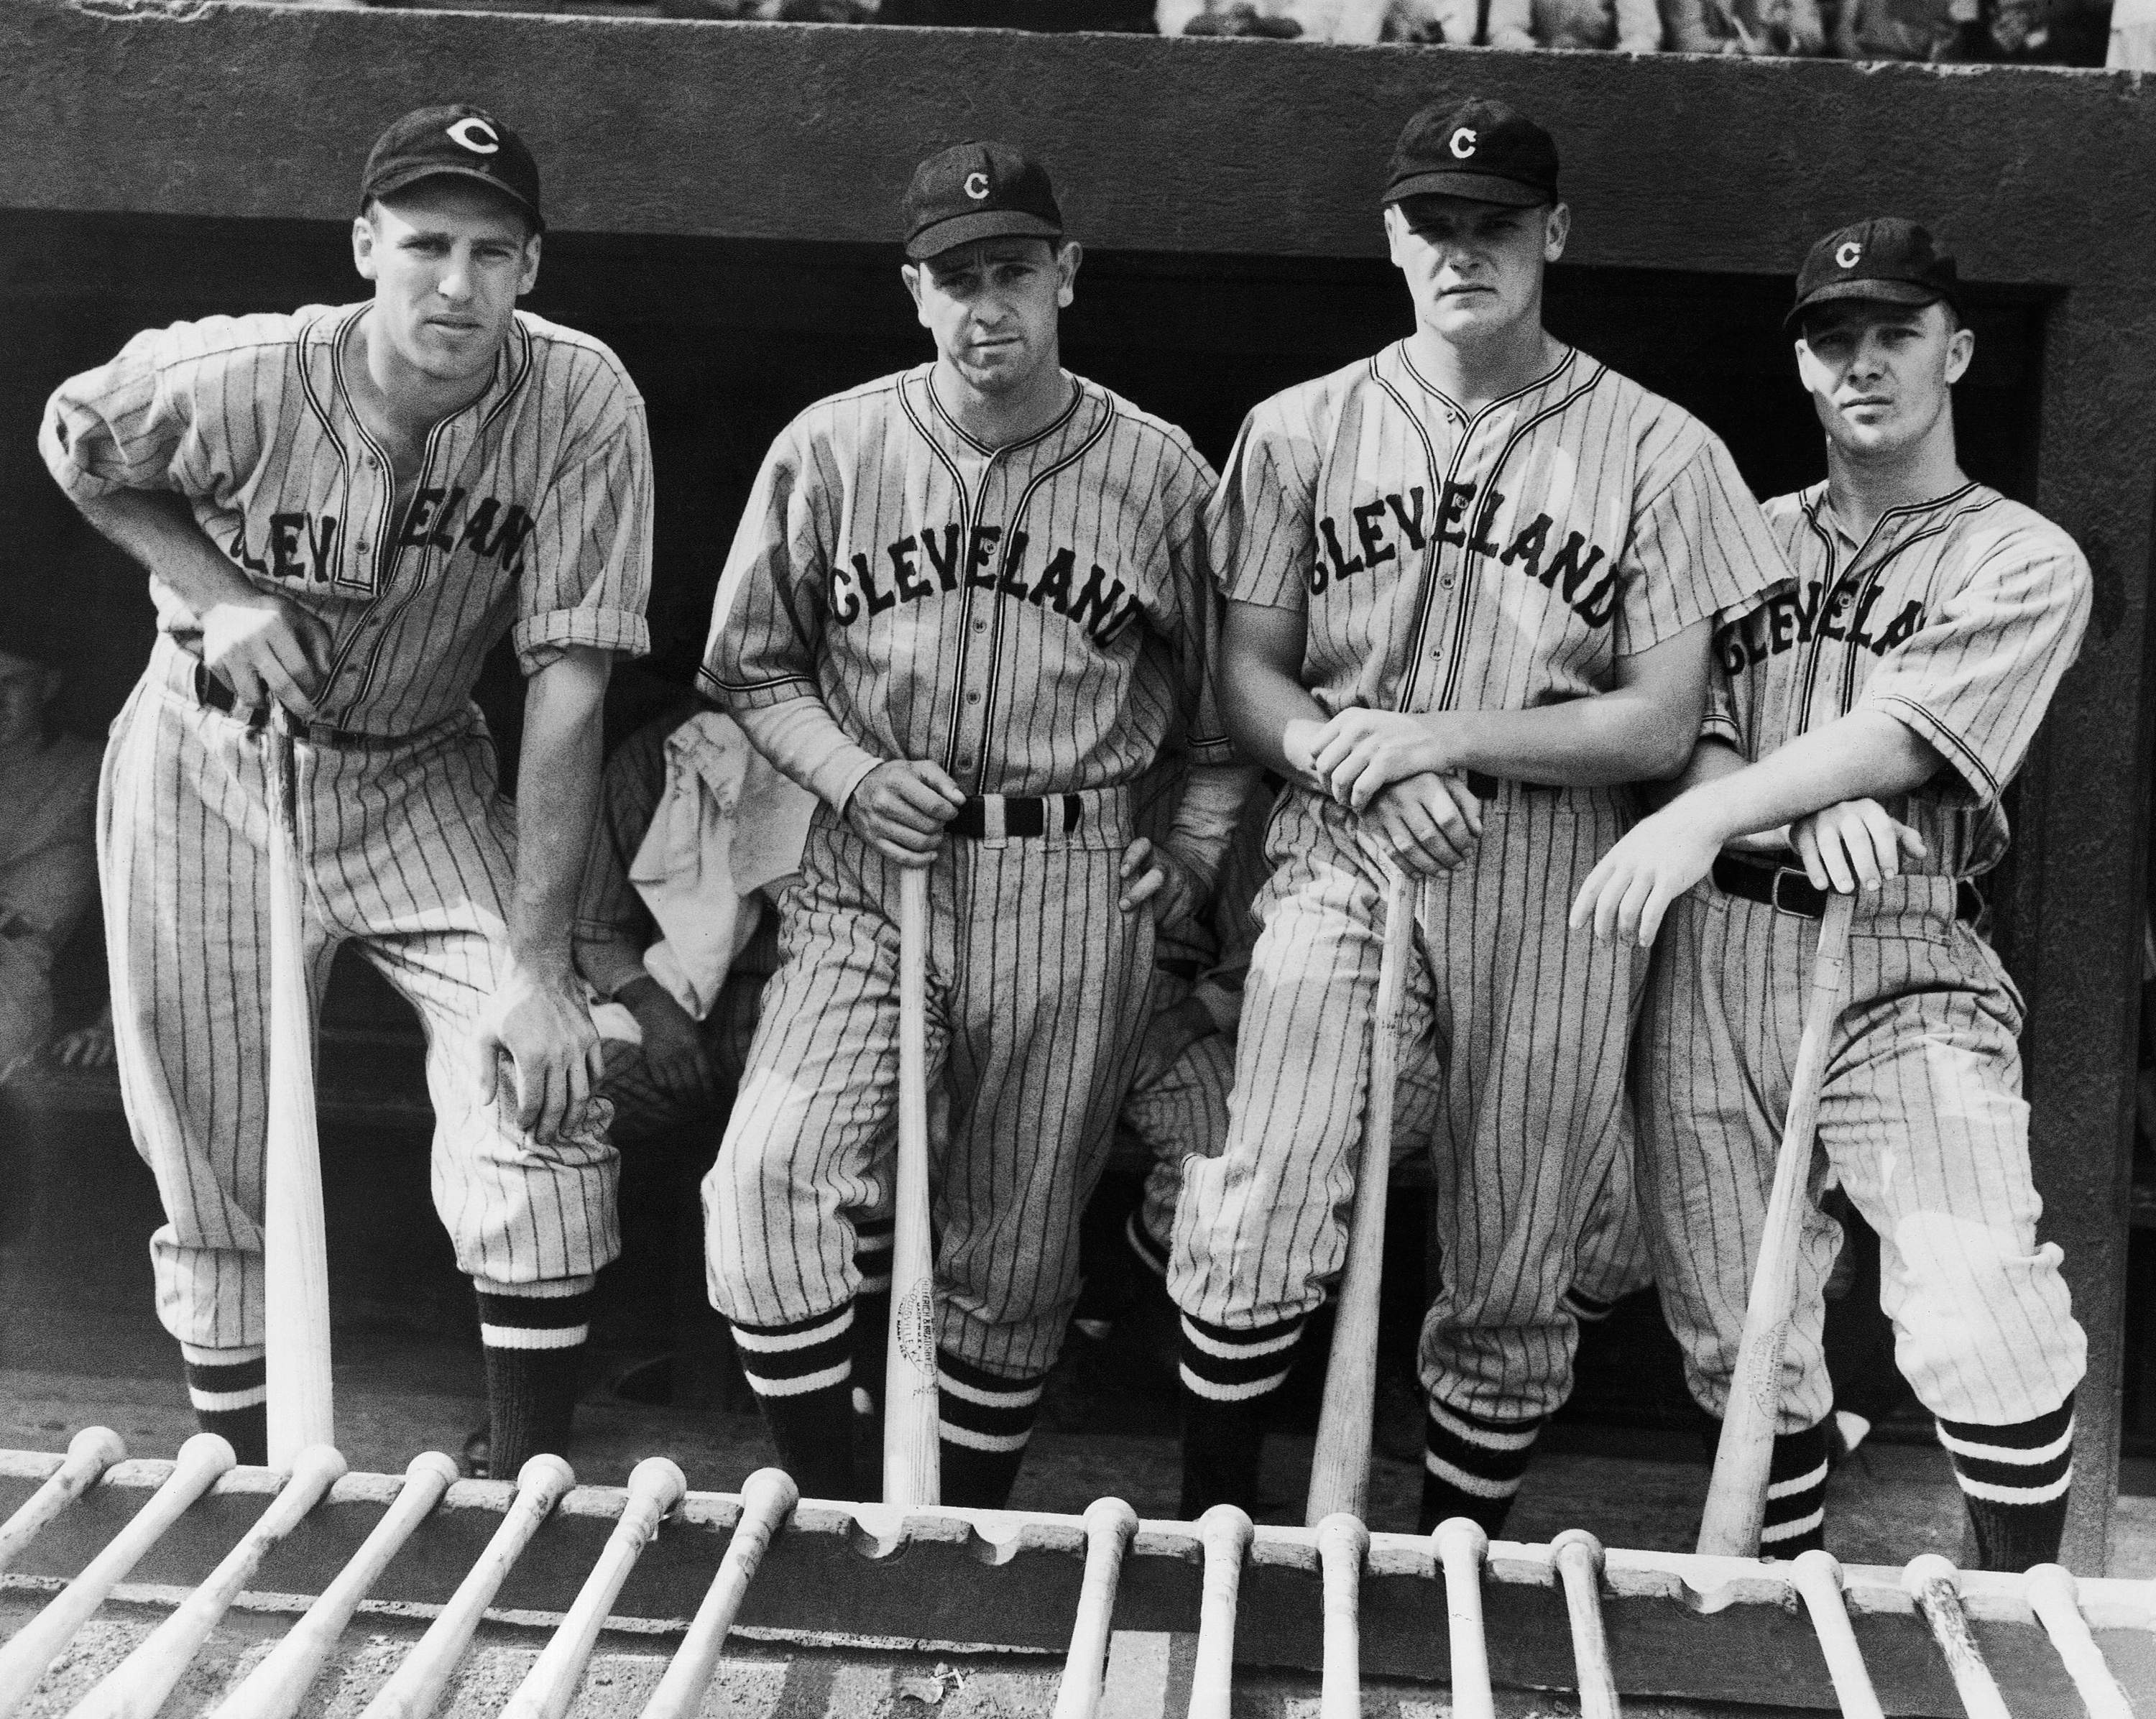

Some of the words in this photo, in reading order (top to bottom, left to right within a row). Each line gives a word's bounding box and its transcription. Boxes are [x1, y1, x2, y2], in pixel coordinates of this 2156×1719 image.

[446, 117, 499, 154] C
[1449, 127, 1478, 159] C
[963, 172, 990, 199] C
[1835, 241, 1861, 268] C
